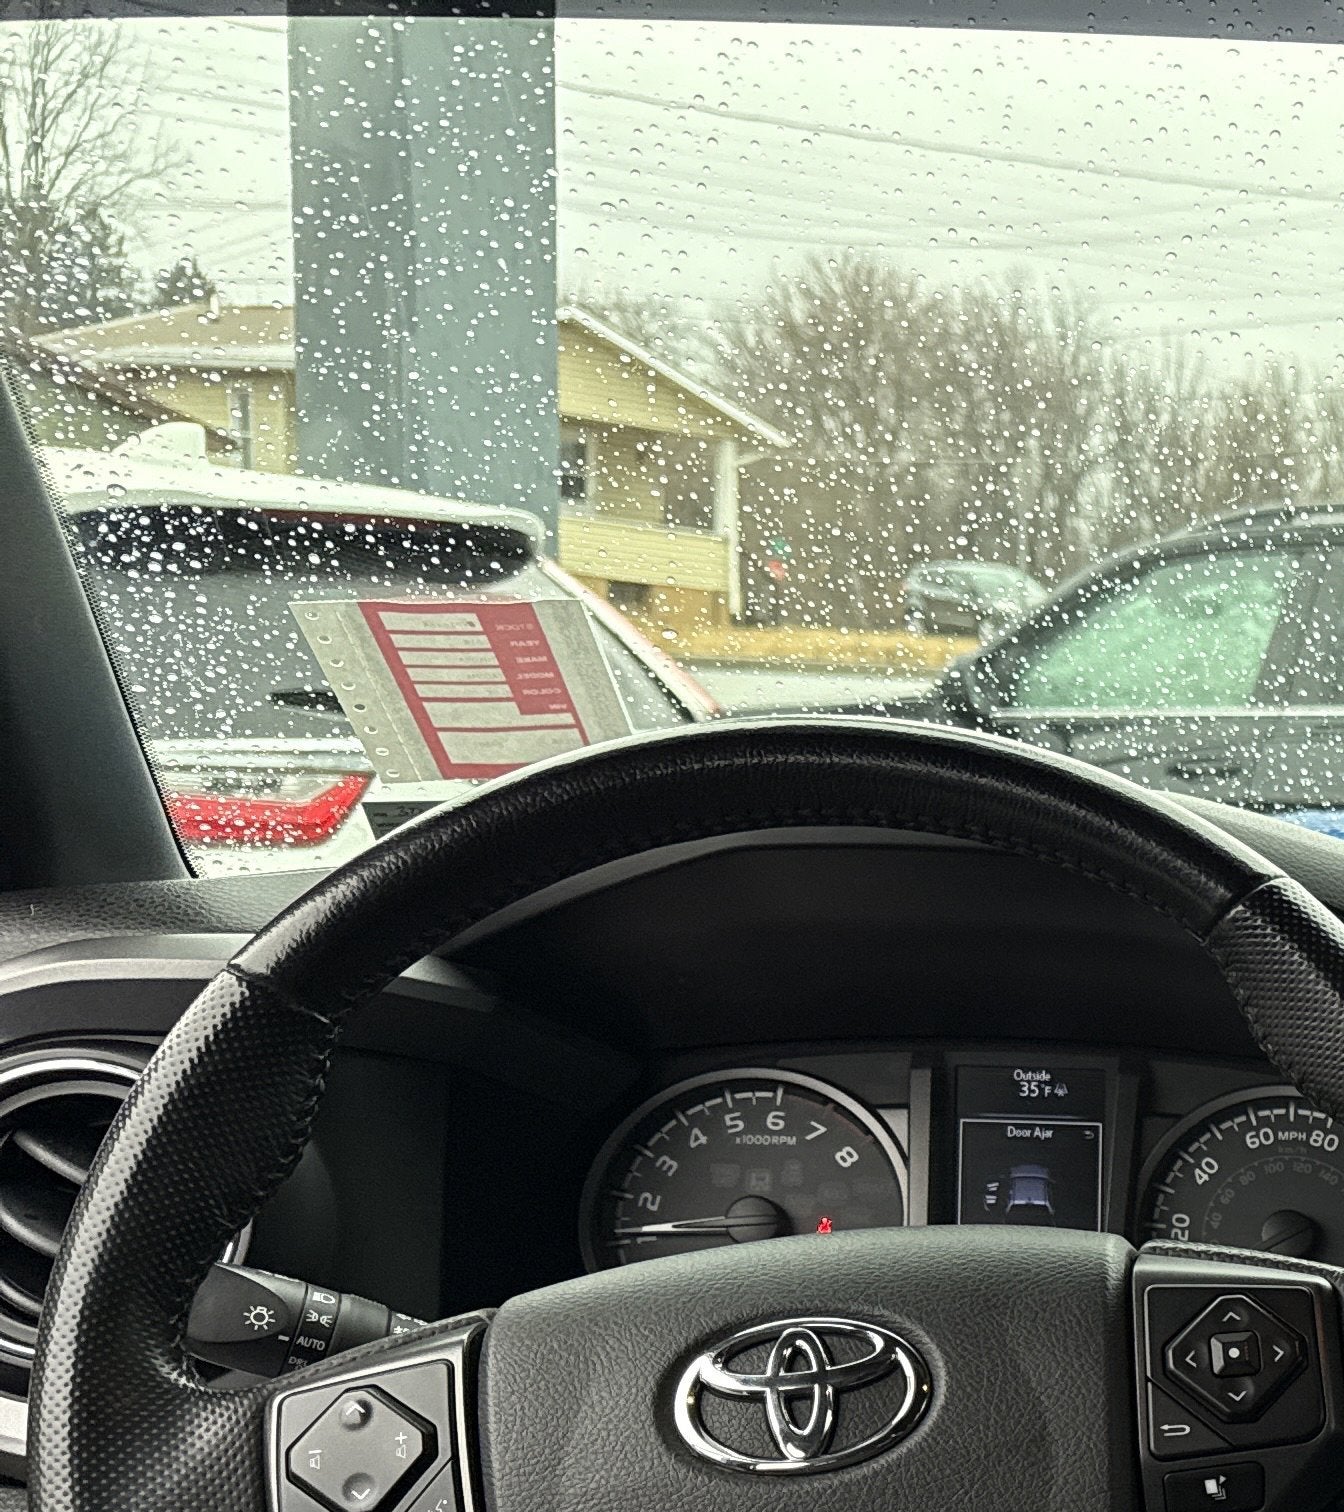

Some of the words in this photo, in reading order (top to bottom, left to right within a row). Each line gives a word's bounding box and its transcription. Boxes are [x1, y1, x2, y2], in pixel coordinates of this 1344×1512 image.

[1013, 1068, 1052, 1082] Outside
[724, 1112, 745, 1134] 5
[766, 1111, 786, 1131] 6
[805, 1120, 828, 1141] 7
[688, 1127, 708, 1149] 4
[1007, 1125, 1031, 1138] Door
[1034, 1126, 1054, 1140] Ajar
[1245, 1127, 1274, 1150] 60
[1277, 1131, 1307, 1142] MPH
[1309, 1129, 1339, 1152] 80
[655, 1154, 678, 1177] 3
[834, 1146, 859, 1168] 8
[1193, 1156, 1219, 1186] 40
[637, 1191, 661, 1212] 2
[1171, 1213, 1190, 1242] 20
[296, 1335, 326, 1351] AUTO
